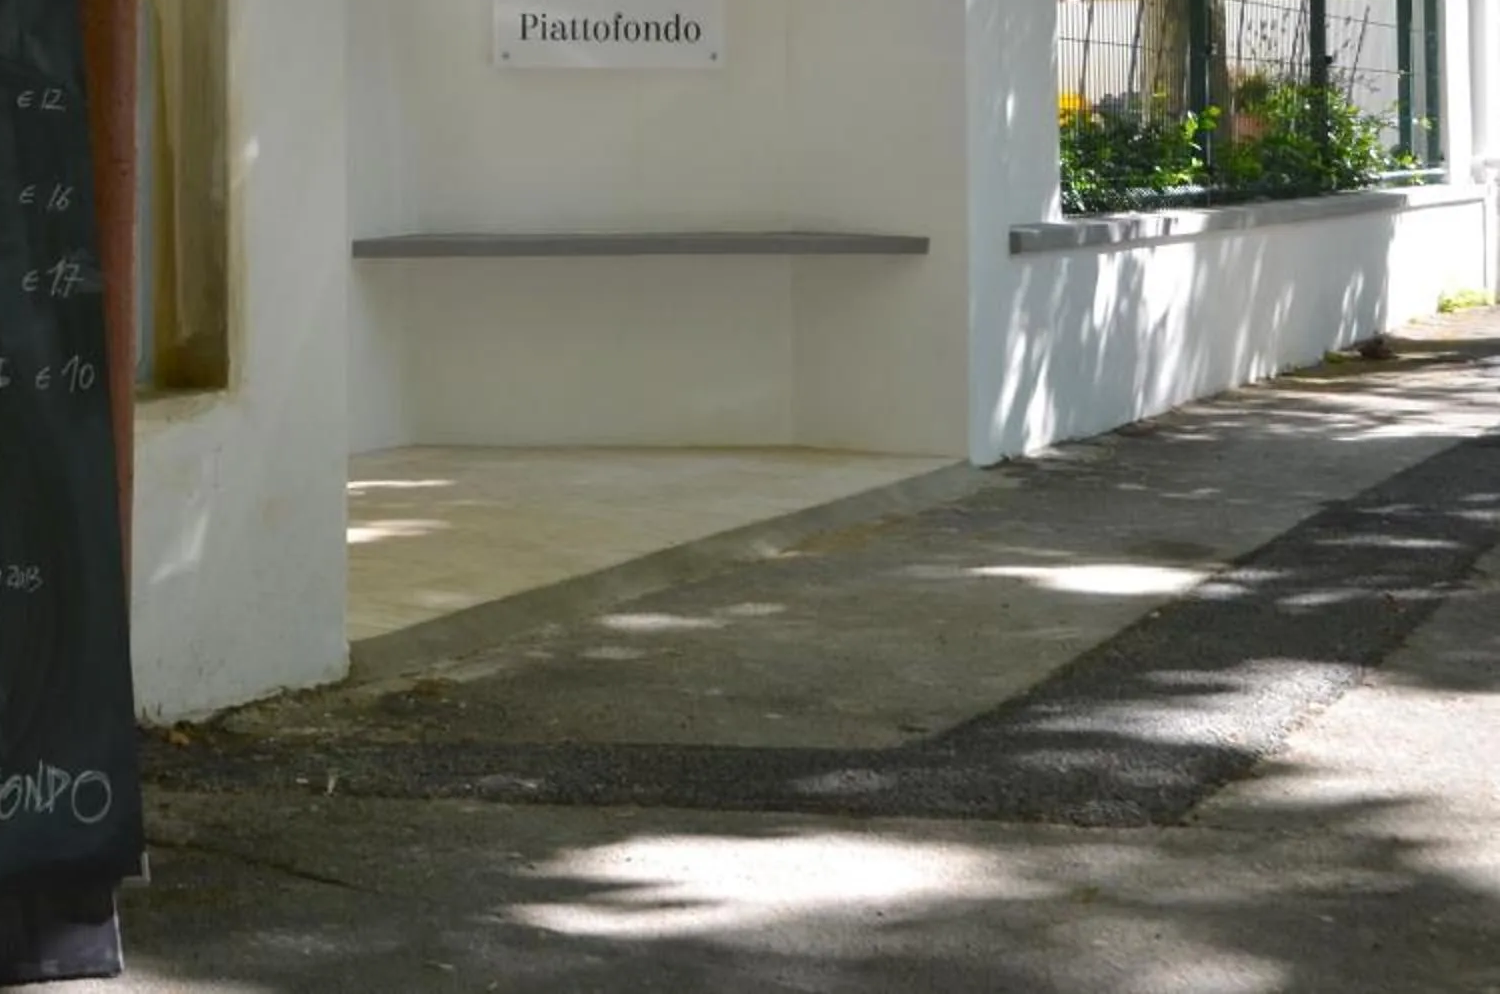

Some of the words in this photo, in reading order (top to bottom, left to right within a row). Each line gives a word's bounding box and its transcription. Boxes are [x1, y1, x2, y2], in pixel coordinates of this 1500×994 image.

[519, 11, 702, 43] Piattofondo
[16, 91, 34, 107] €
[18, 185, 36, 204] €
[45, 182, 75, 212] 16
[21, 270, 39, 292] €
[46, 257, 86, 297] 17
[34, 367, 52, 390] €
[60, 354, 97, 392] 10
